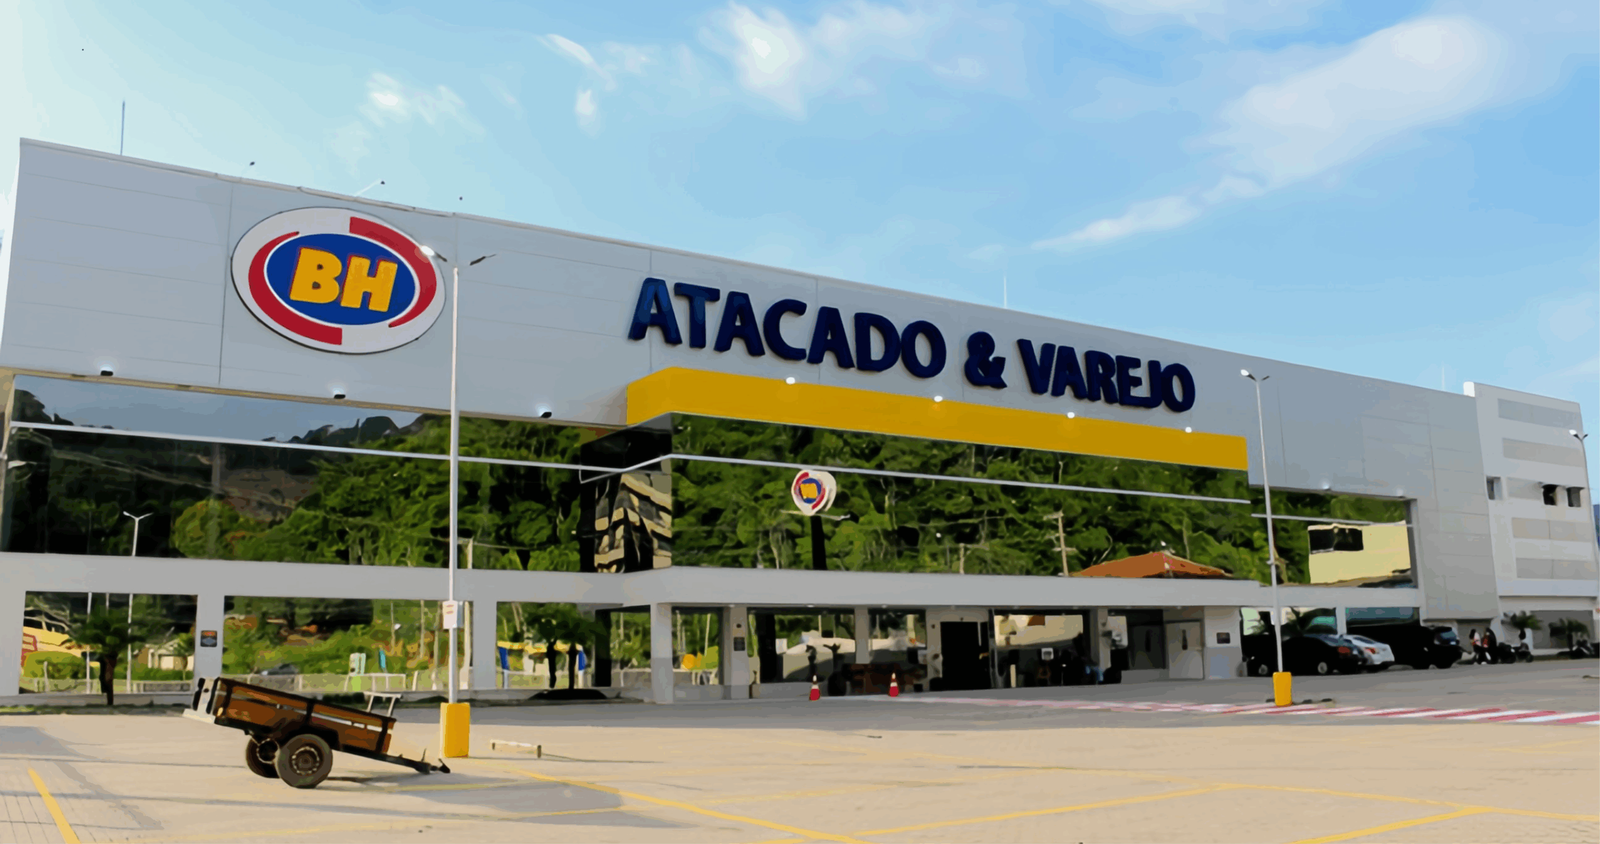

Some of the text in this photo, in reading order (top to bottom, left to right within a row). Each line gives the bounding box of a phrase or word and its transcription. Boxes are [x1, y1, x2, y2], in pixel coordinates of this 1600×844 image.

[289, 246, 398, 313] BH
[627, 277, 1196, 413] ATACADO & VAREJO
